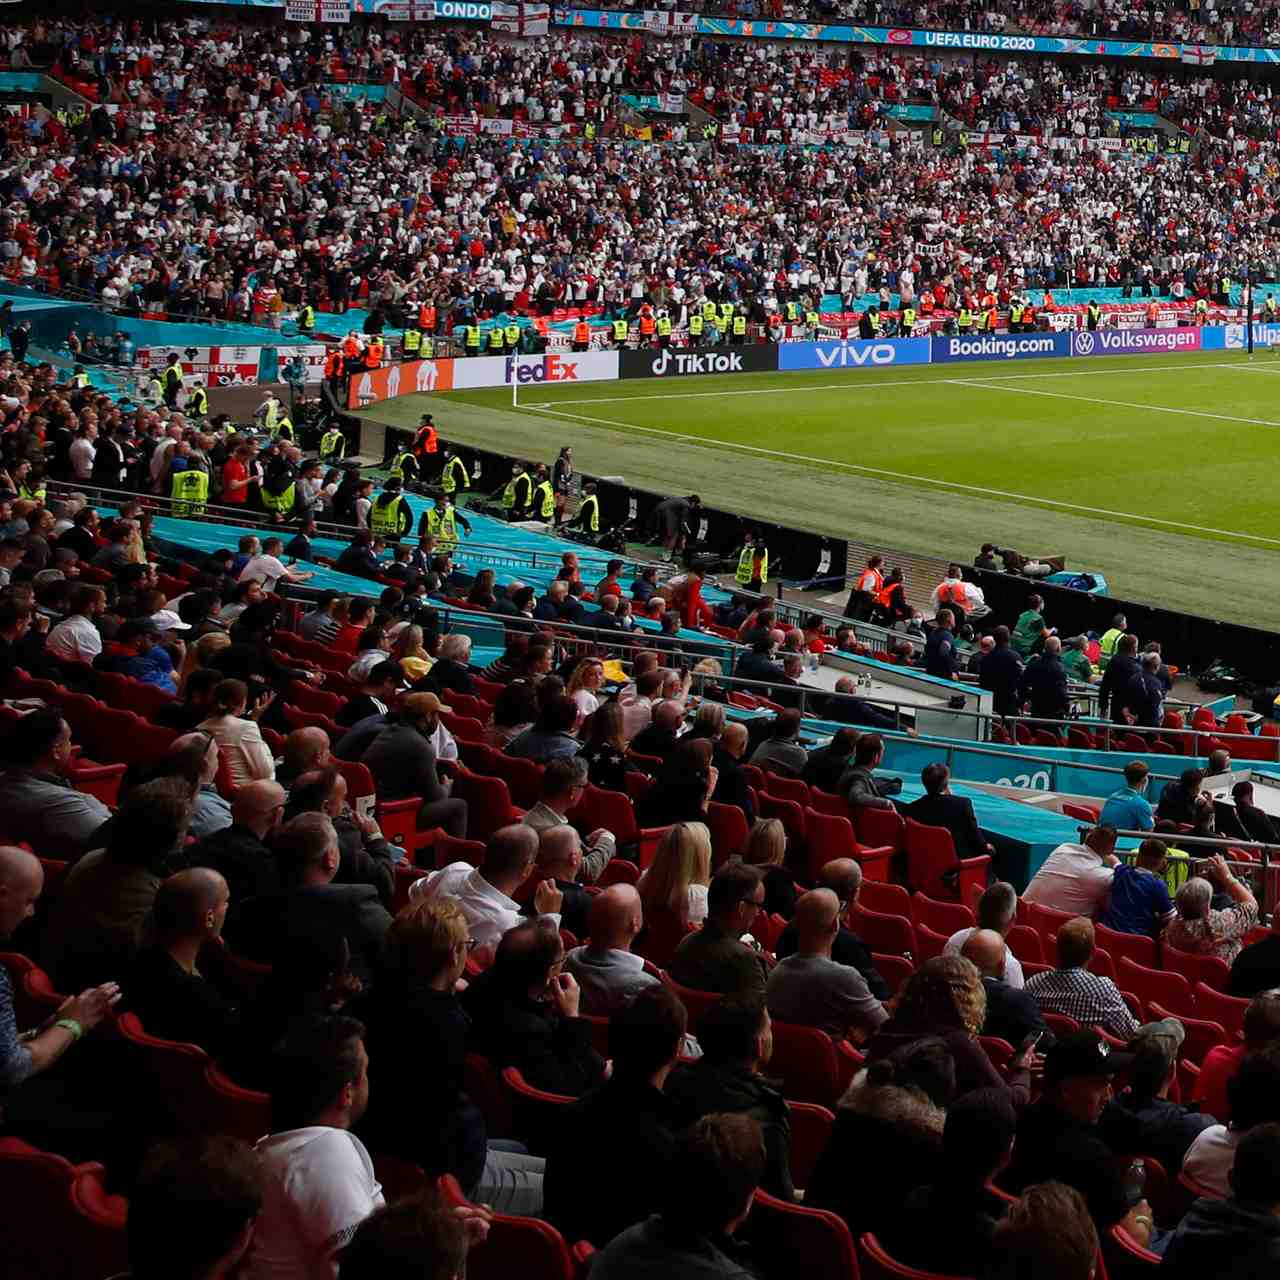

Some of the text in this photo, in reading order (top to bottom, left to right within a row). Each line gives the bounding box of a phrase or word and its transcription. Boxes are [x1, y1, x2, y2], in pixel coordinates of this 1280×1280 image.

[434, 1, 493, 20] LONDO
[926, 32, 1036, 50] UEFA EURO 2020
[950, 337, 1054, 356] Booking.com
[1100, 331, 1195, 349] Volkswagen
[675, 351, 743, 374] TikTok
[815, 341, 896, 367] vivo
[505, 354, 578, 383] FedEx
